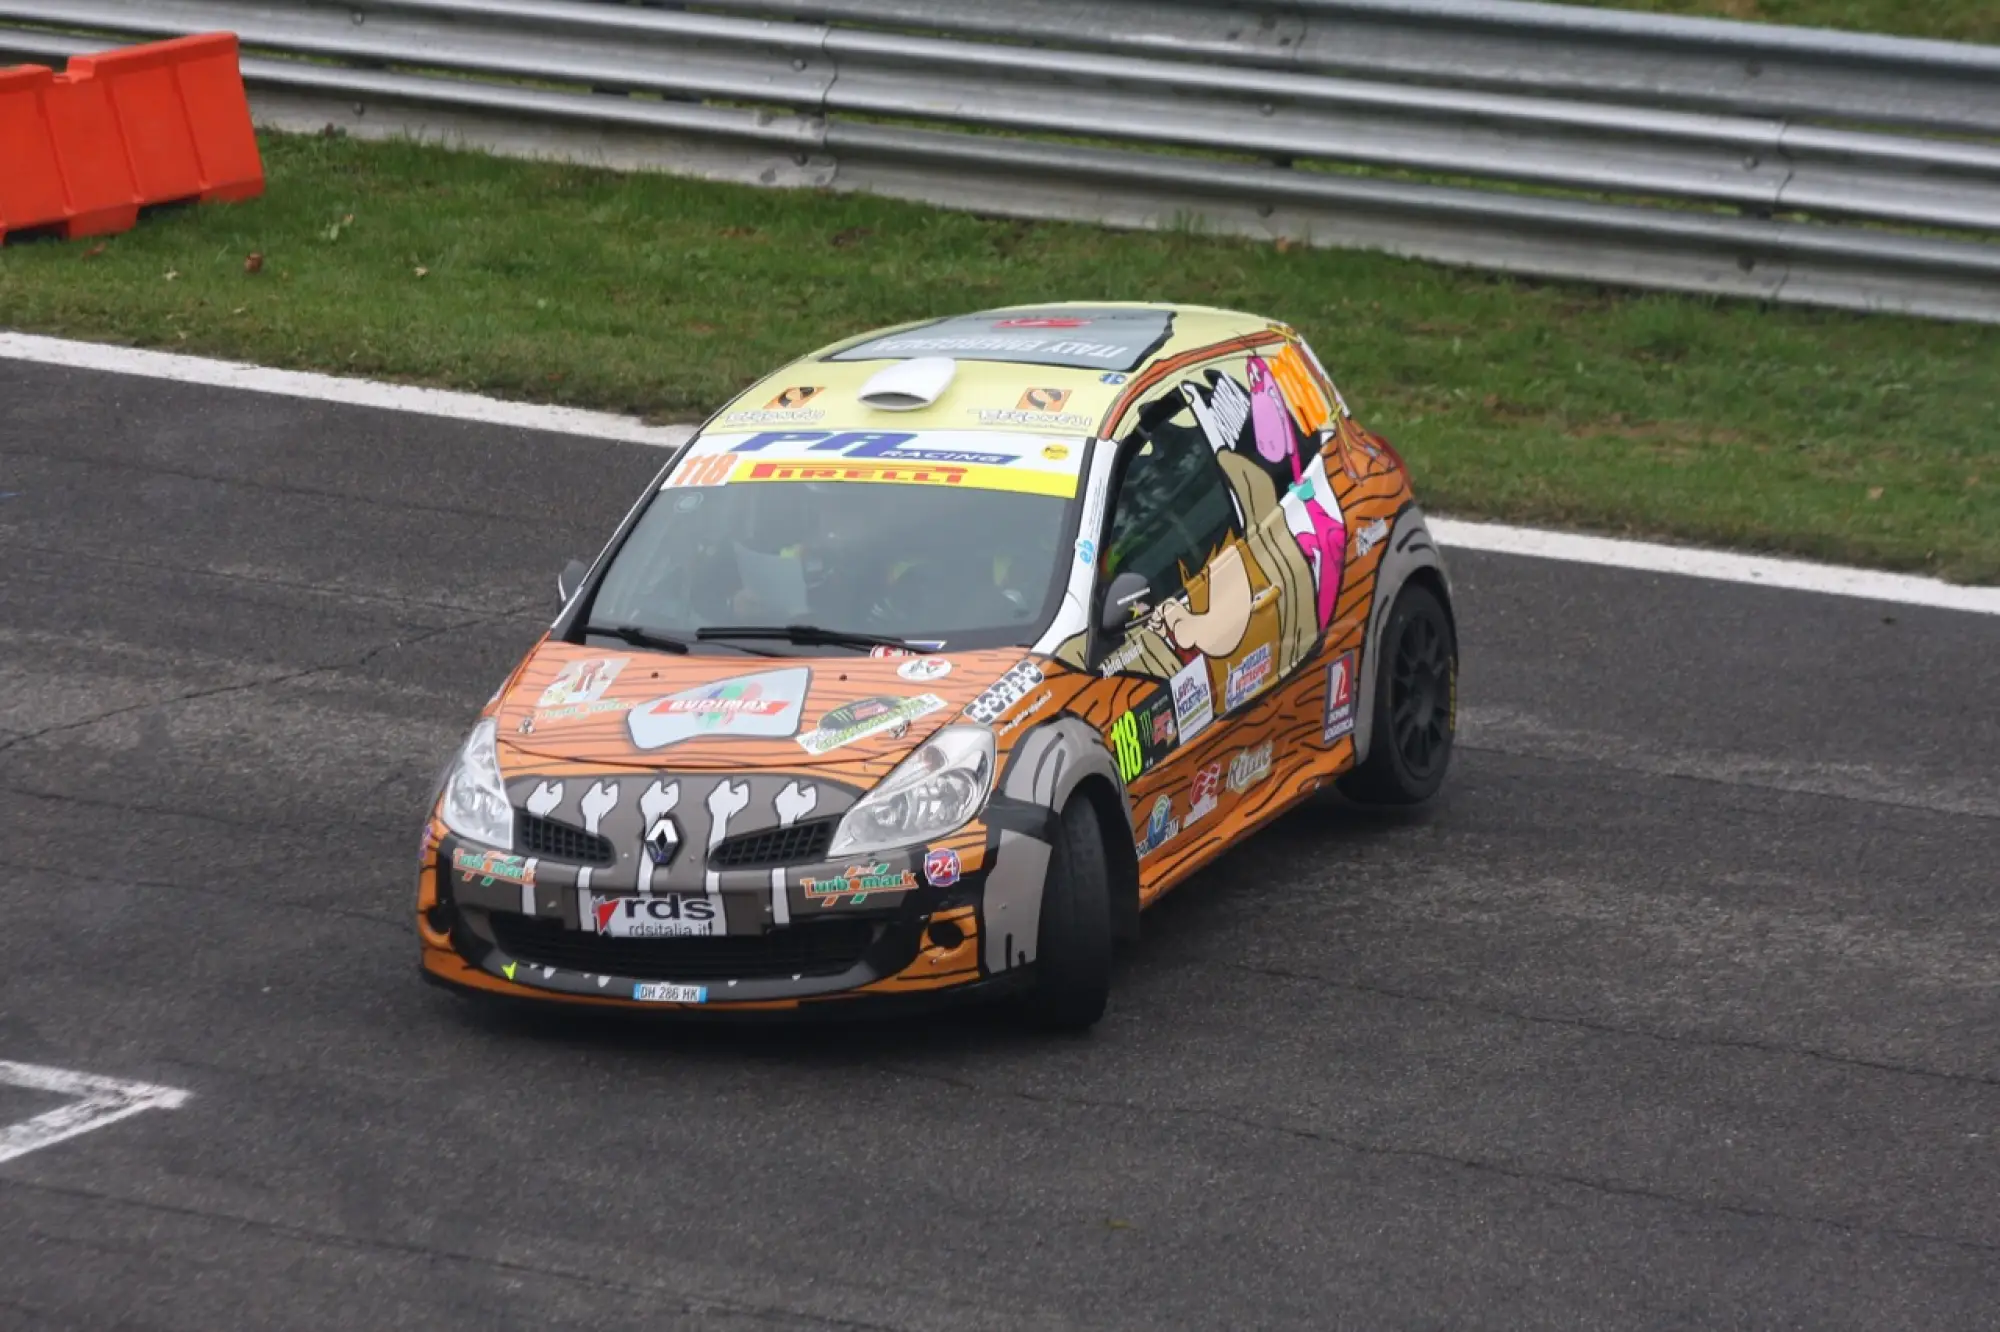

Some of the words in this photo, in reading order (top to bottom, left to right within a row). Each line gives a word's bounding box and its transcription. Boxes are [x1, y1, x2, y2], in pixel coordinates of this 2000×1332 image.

[1043, 341, 1128, 359] ITALY
[879, 448, 1004, 464] RACING
[673, 452, 739, 485] 118
[749, 463, 968, 484] PIRELLI
[1110, 710, 1143, 785] 118
[930, 859, 956, 878] 24
[625, 893, 715, 921] rds
[640, 983, 656, 999] DH
[660, 985, 679, 1000] 286
